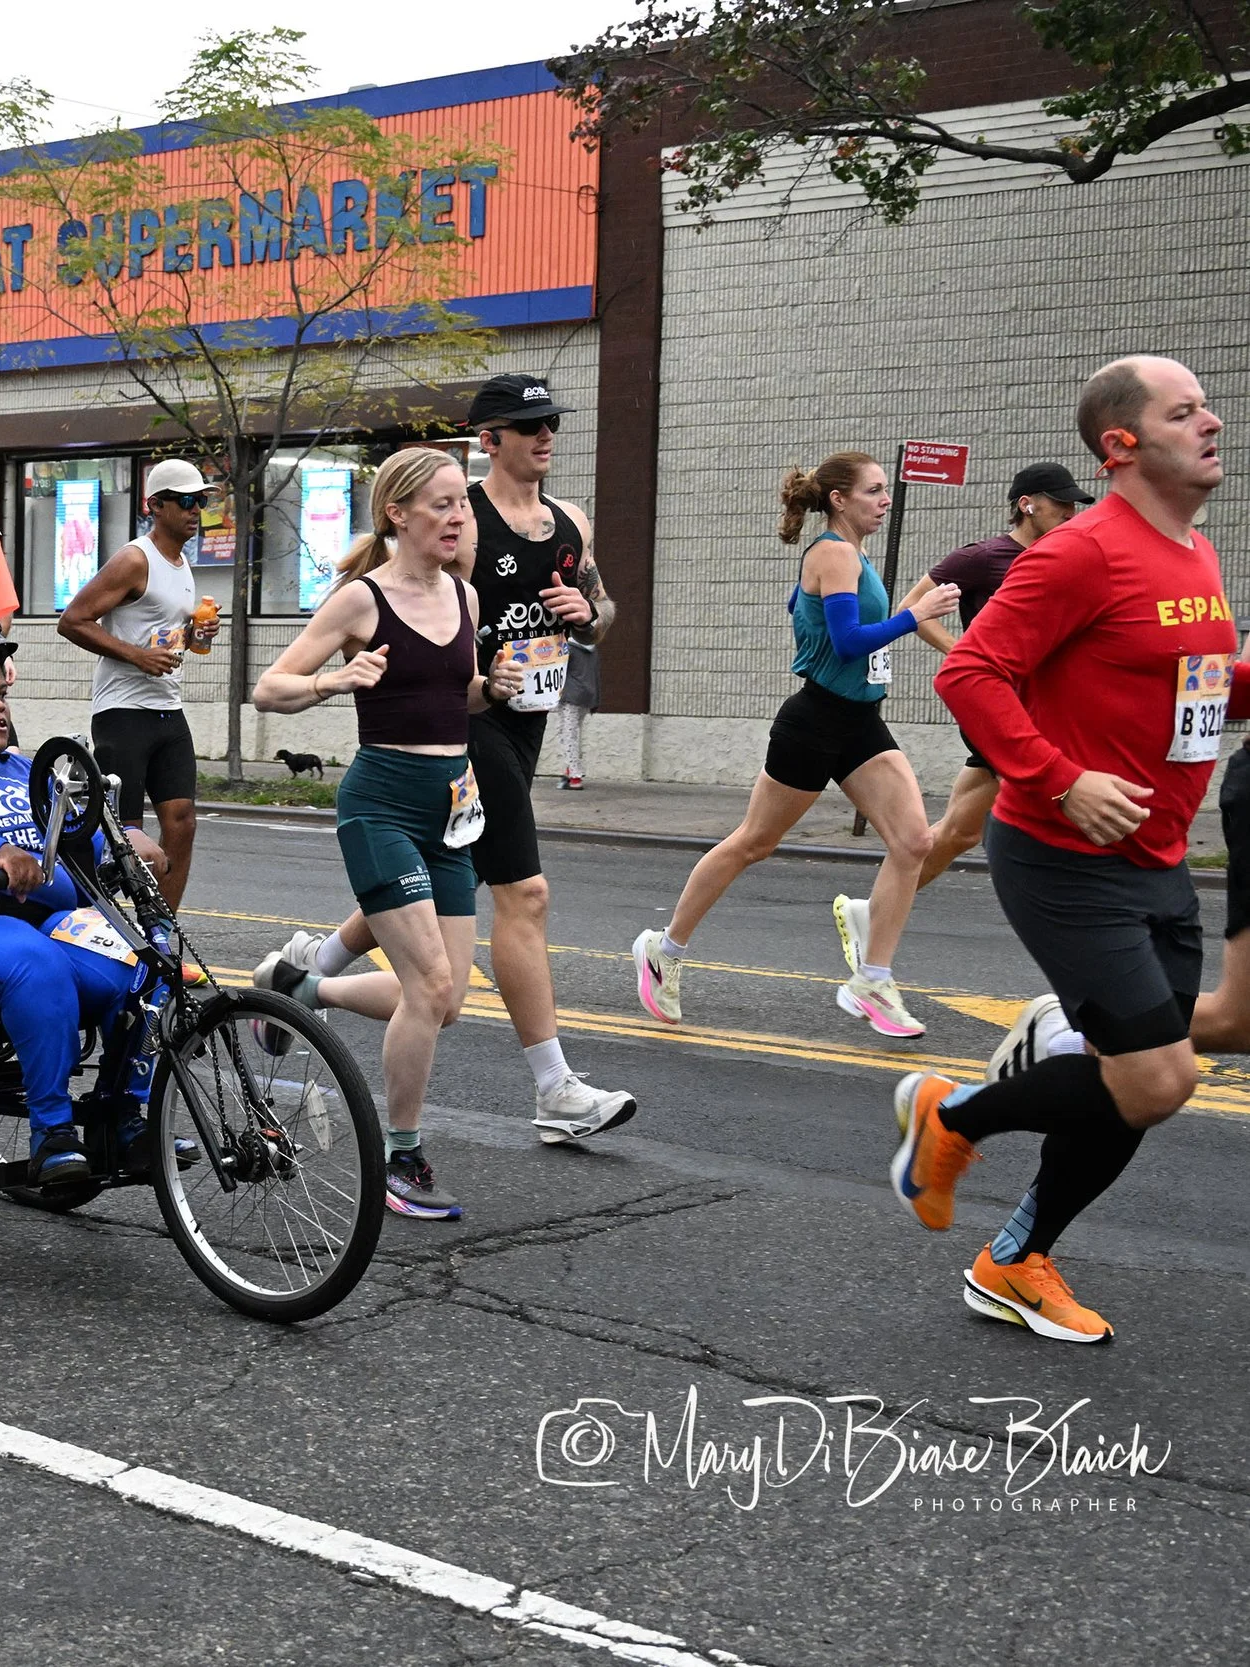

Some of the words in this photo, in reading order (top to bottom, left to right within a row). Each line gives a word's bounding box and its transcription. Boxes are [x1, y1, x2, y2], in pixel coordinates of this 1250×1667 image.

[56, 160, 498, 286] SUPERMARKET
[907, 444, 919, 453] NO
[920, 446, 959, 457] STANDING
[906, 454, 940, 465] Anytime
[871, 655, 878, 671] C
[1181, 706, 1194, 736] B
[2, 828, 40, 846] THE
